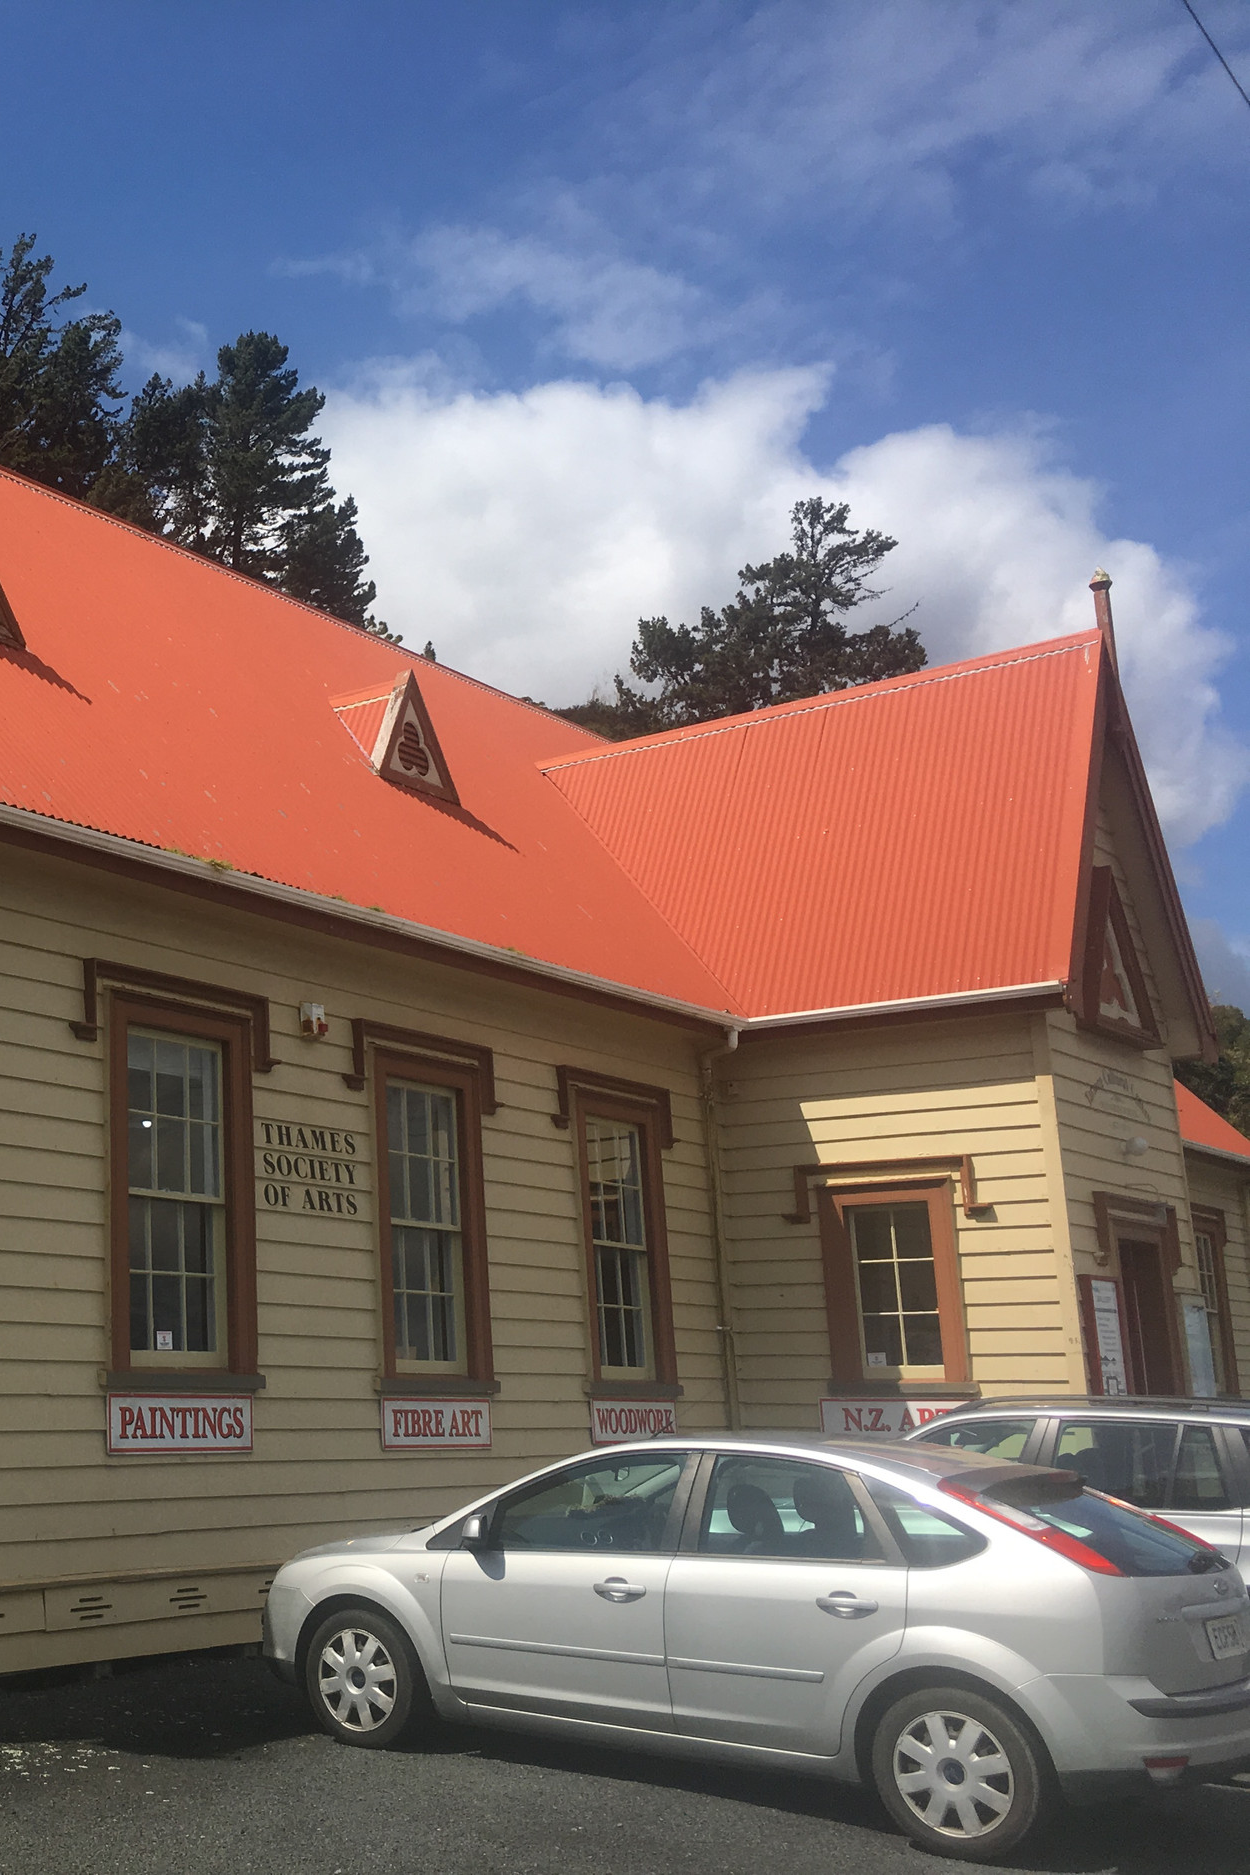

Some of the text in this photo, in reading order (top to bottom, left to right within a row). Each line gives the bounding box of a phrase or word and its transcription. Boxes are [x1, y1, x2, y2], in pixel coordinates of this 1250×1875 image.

[261, 1122, 356, 1155] THAMES
[263, 1152, 356, 1185] SOCIETY
[264, 1183, 358, 1215] OF ARTS
[119, 1406, 245, 1439] PAINTINGS
[392, 1409, 483, 1437] FIBRE ART
[596, 1408, 675, 1434] WOODWORK
[842, 1408, 891, 1432] N.Z.
